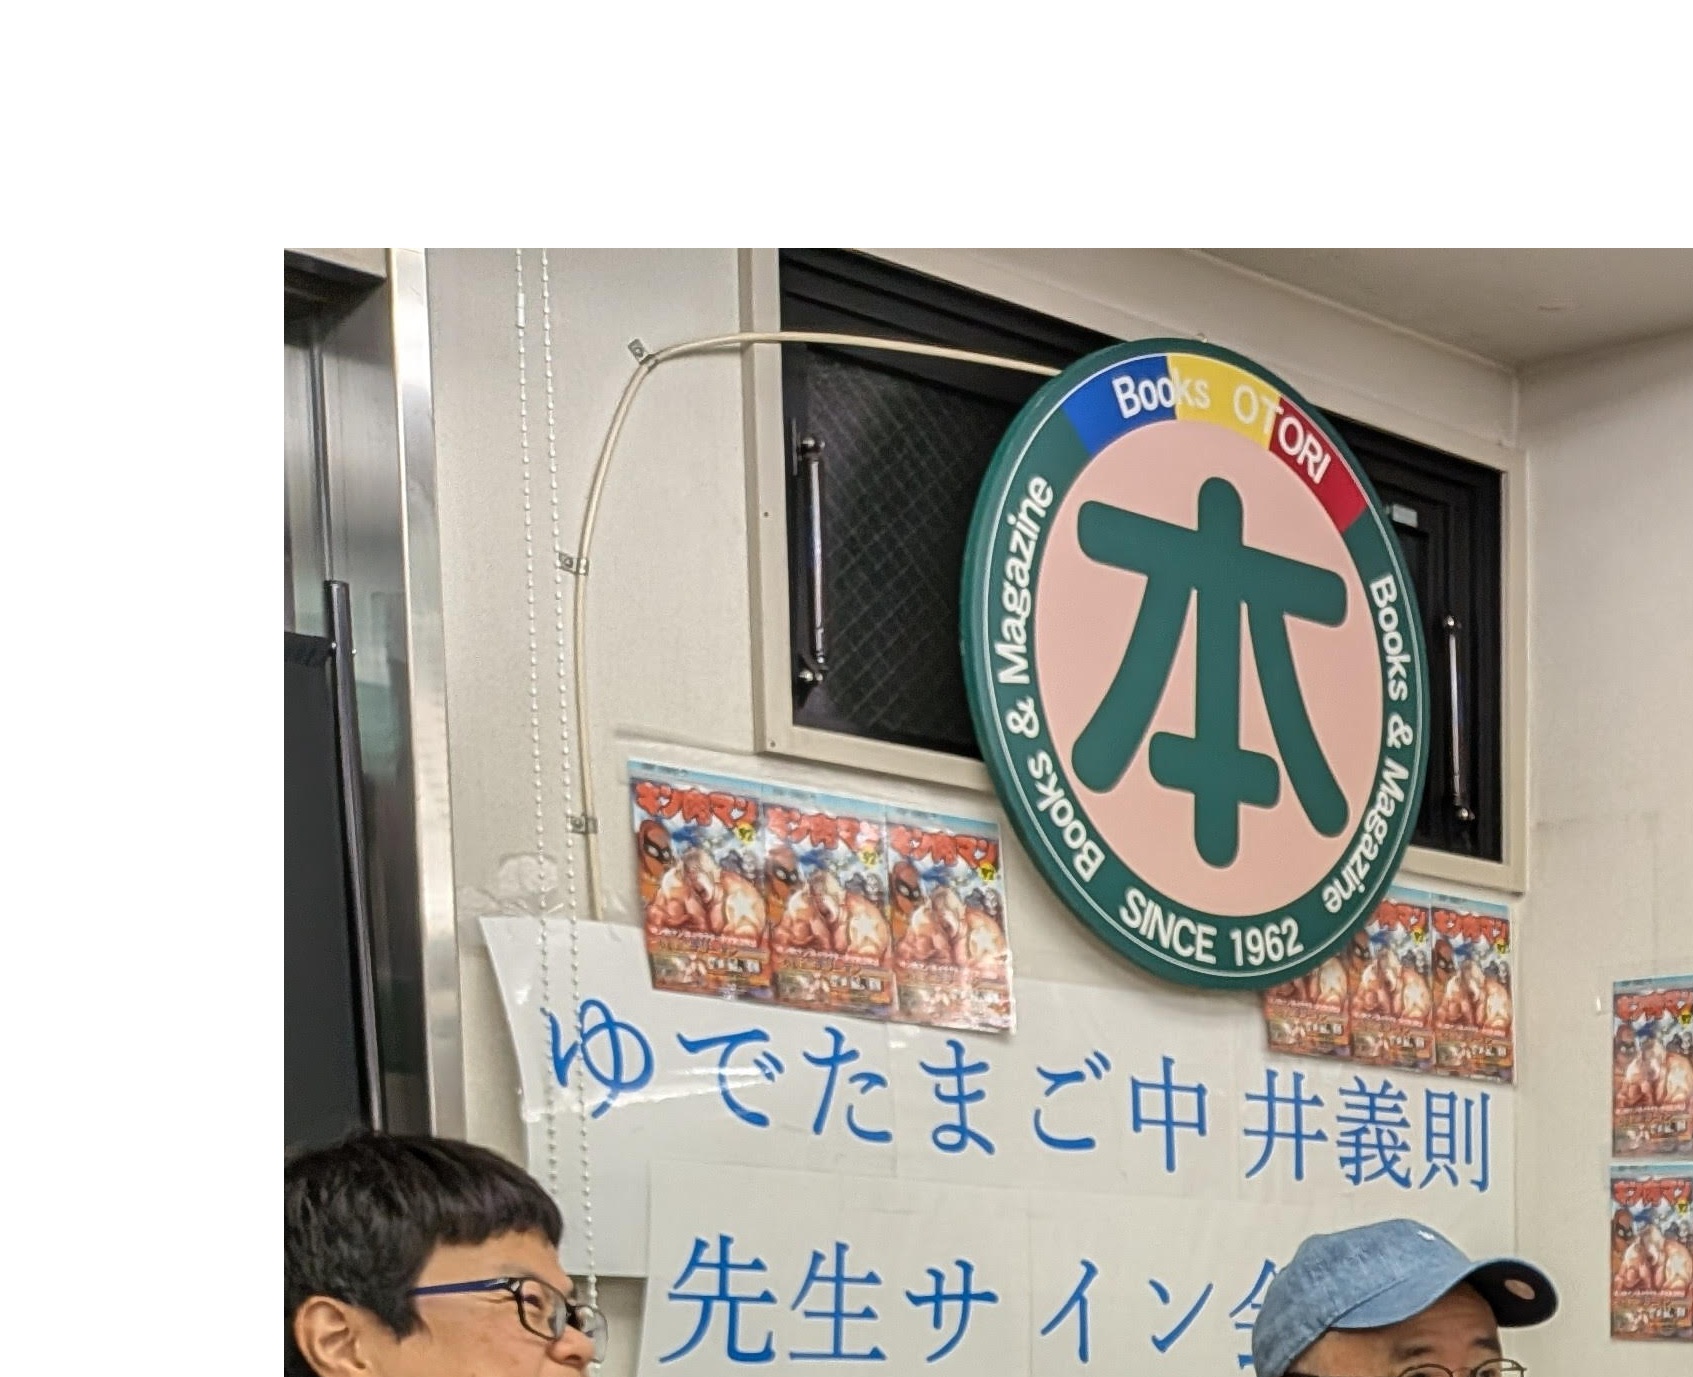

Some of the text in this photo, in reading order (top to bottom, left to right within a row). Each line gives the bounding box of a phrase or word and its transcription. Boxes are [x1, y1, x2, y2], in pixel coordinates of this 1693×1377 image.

[1112, 374, 1332, 484] Books OTORI
[994, 475, 1106, 882] Books & Magazine
[1070, 476, 1349, 869] 本
[1324, 573, 1414, 913] Books & Magazine
[1119, 888, 1304, 967] SINCE 1962
[540, 998, 1491, 1192] ゆでたまご中井義則
